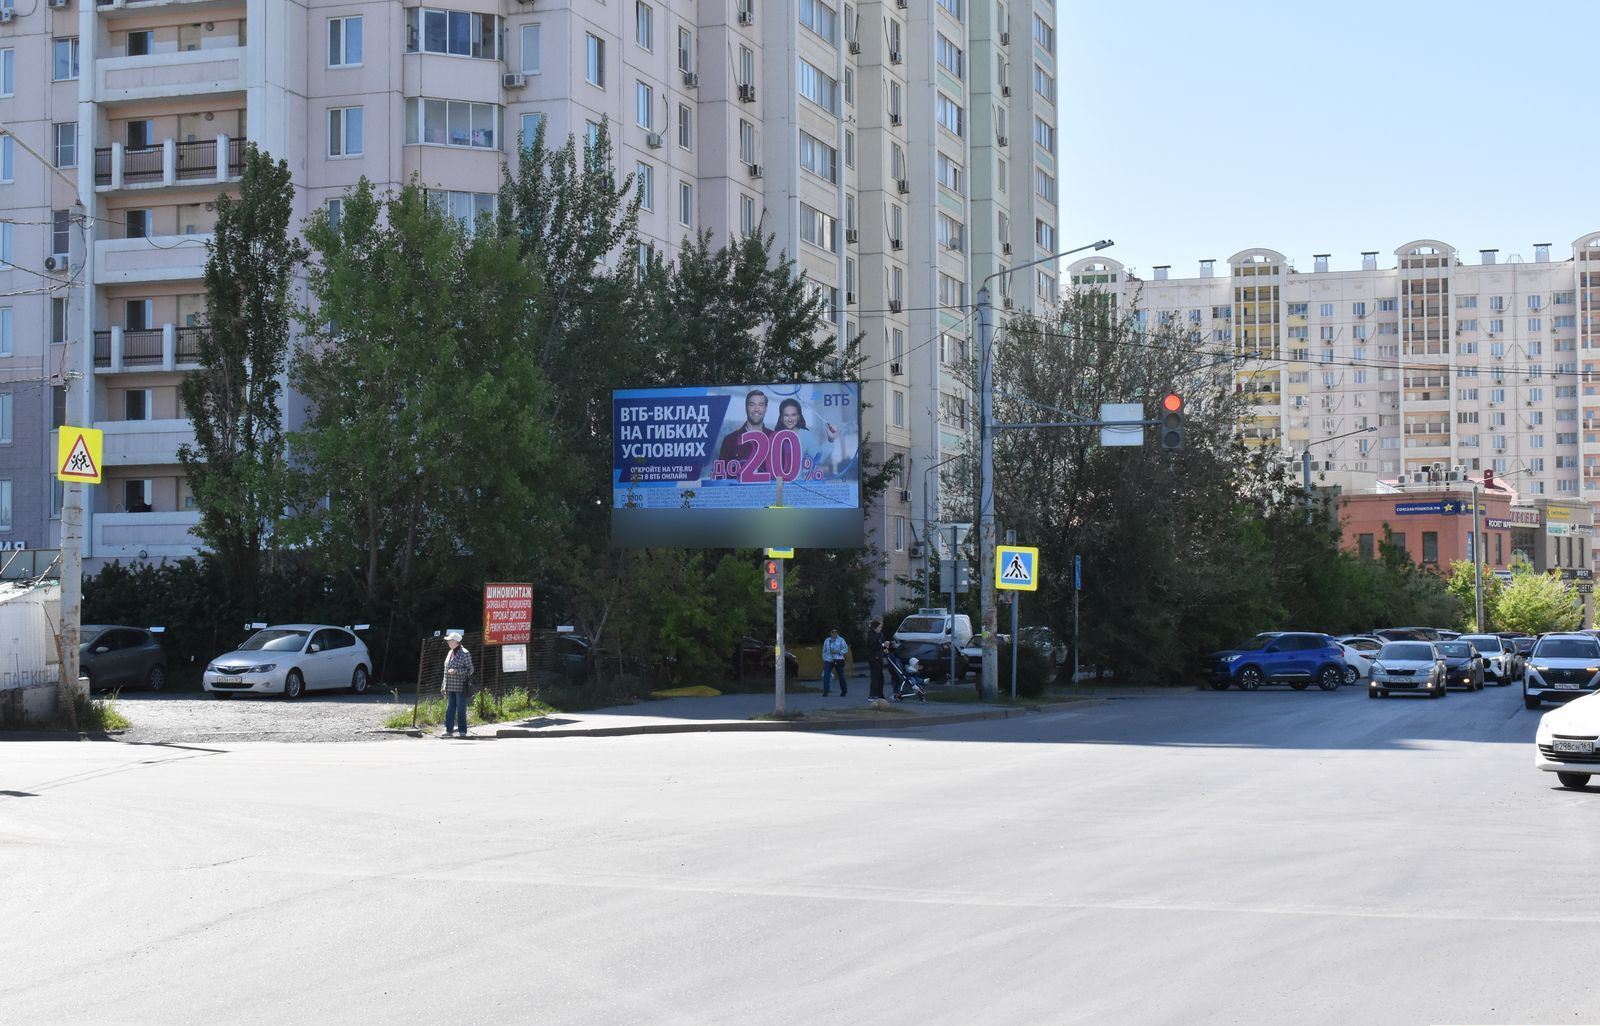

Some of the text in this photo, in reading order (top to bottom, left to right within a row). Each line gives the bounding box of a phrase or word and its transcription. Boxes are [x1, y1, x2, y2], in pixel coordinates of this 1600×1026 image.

[824, 394, 850, 406] ВТБ
[621, 405, 710, 422] ВТБ-ВКЛАД
[621, 423, 708, 440] НА ГИБКИХ
[621, 442, 706, 458] УСЛОВИЯХ
[661, 472, 688, 480] ОНЛАЙН
[487, 586, 532, 598] ШИНОМОНТАЖ
